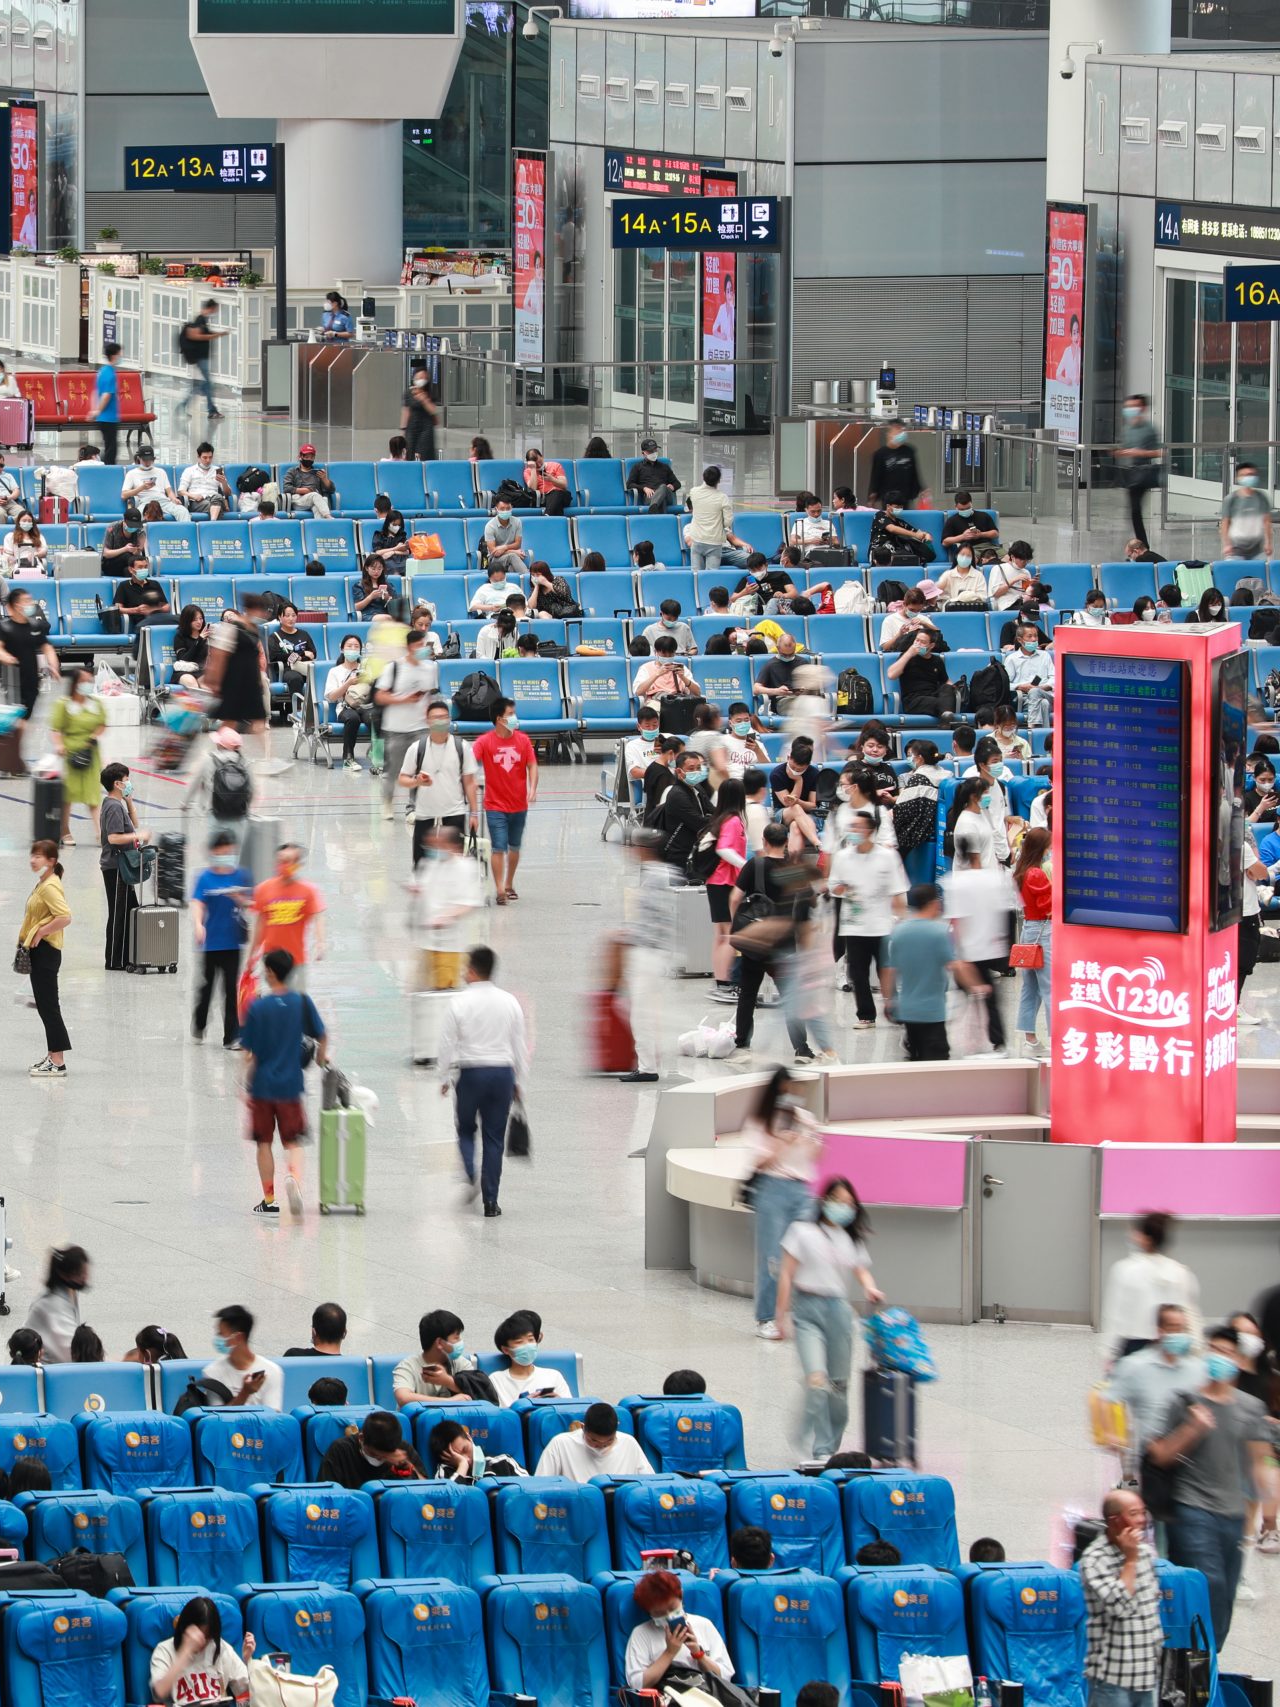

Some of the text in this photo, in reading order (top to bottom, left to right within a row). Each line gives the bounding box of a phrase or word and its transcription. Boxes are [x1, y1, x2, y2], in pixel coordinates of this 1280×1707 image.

[220, 168, 243, 177] 检票口
[607, 158, 624, 184] 12A
[717, 224, 743, 234] 检票口
[1159, 212, 1180, 240] 14A
[1050, 295, 1066, 314] 轻松
[1049, 317, 1065, 337] 加盟
[1070, 960, 1102, 981] 成铁
[1070, 982, 1102, 1003] 在线
[1116, 986, 1191, 1017] 12306
[1061, 1027, 1195, 1077] 多彩黔行
[695, 1422, 712, 1433] 爽客
[30, 1437, 47, 1448] 爽客
[142, 1435, 161, 1445] 爽客
[246, 1437, 264, 1449] 爽客
[907, 1492, 926, 1503] 爽客
[787, 1498, 807, 1510] 爽客
[323, 1508, 341, 1520] 爽客
[438, 1507, 456, 1519] 爽客
[208, 1514, 227, 1526] 爽客
[910, 1593, 929, 1605] 爽客
[1037, 1590, 1059, 1602] 爽客
[432, 1605, 451, 1617] 爽客
[791, 1599, 810, 1611] 爽客
[71, 1616, 92, 1628] 爽客
[312, 1611, 332, 1623] 爽客
